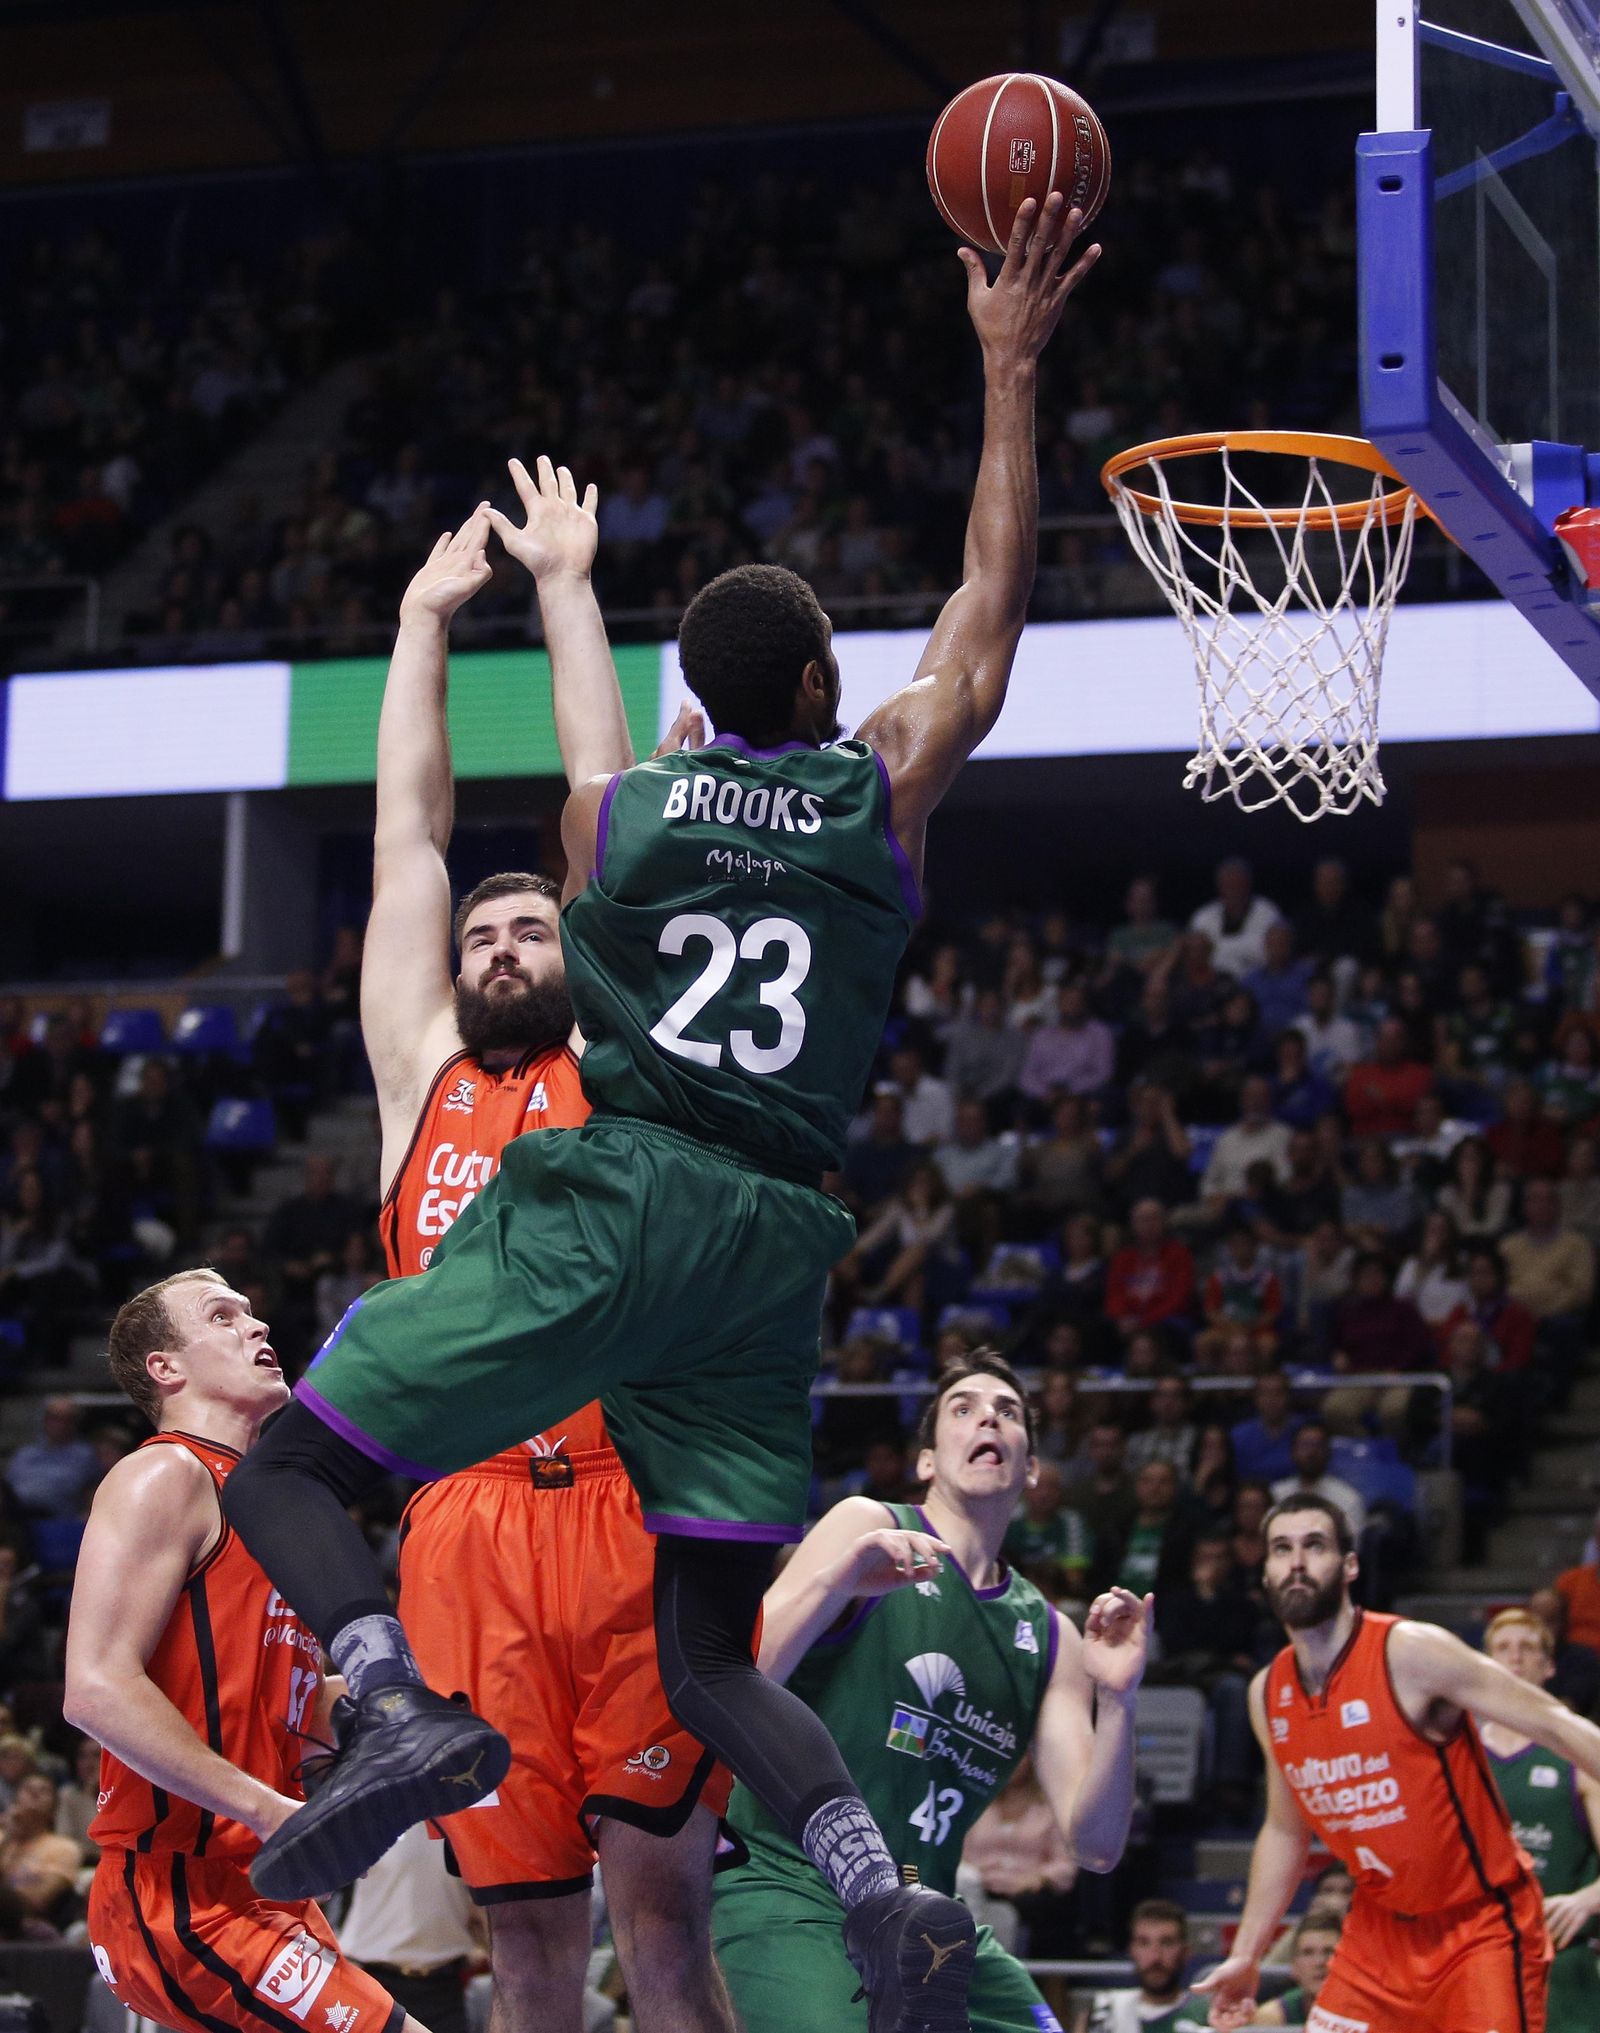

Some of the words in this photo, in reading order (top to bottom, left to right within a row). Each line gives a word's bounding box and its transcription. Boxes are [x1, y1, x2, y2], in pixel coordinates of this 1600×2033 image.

[1022, 142, 1030, 170] Clarino
[662, 774, 824, 834] BROOKS
[706, 849, 787, 886] Málaga
[649, 914, 811, 1074] 23
[954, 1700, 1016, 1750] Unicaja
[908, 1780, 964, 1846] 43
[340, 2007, 360, 2033] uanvi
